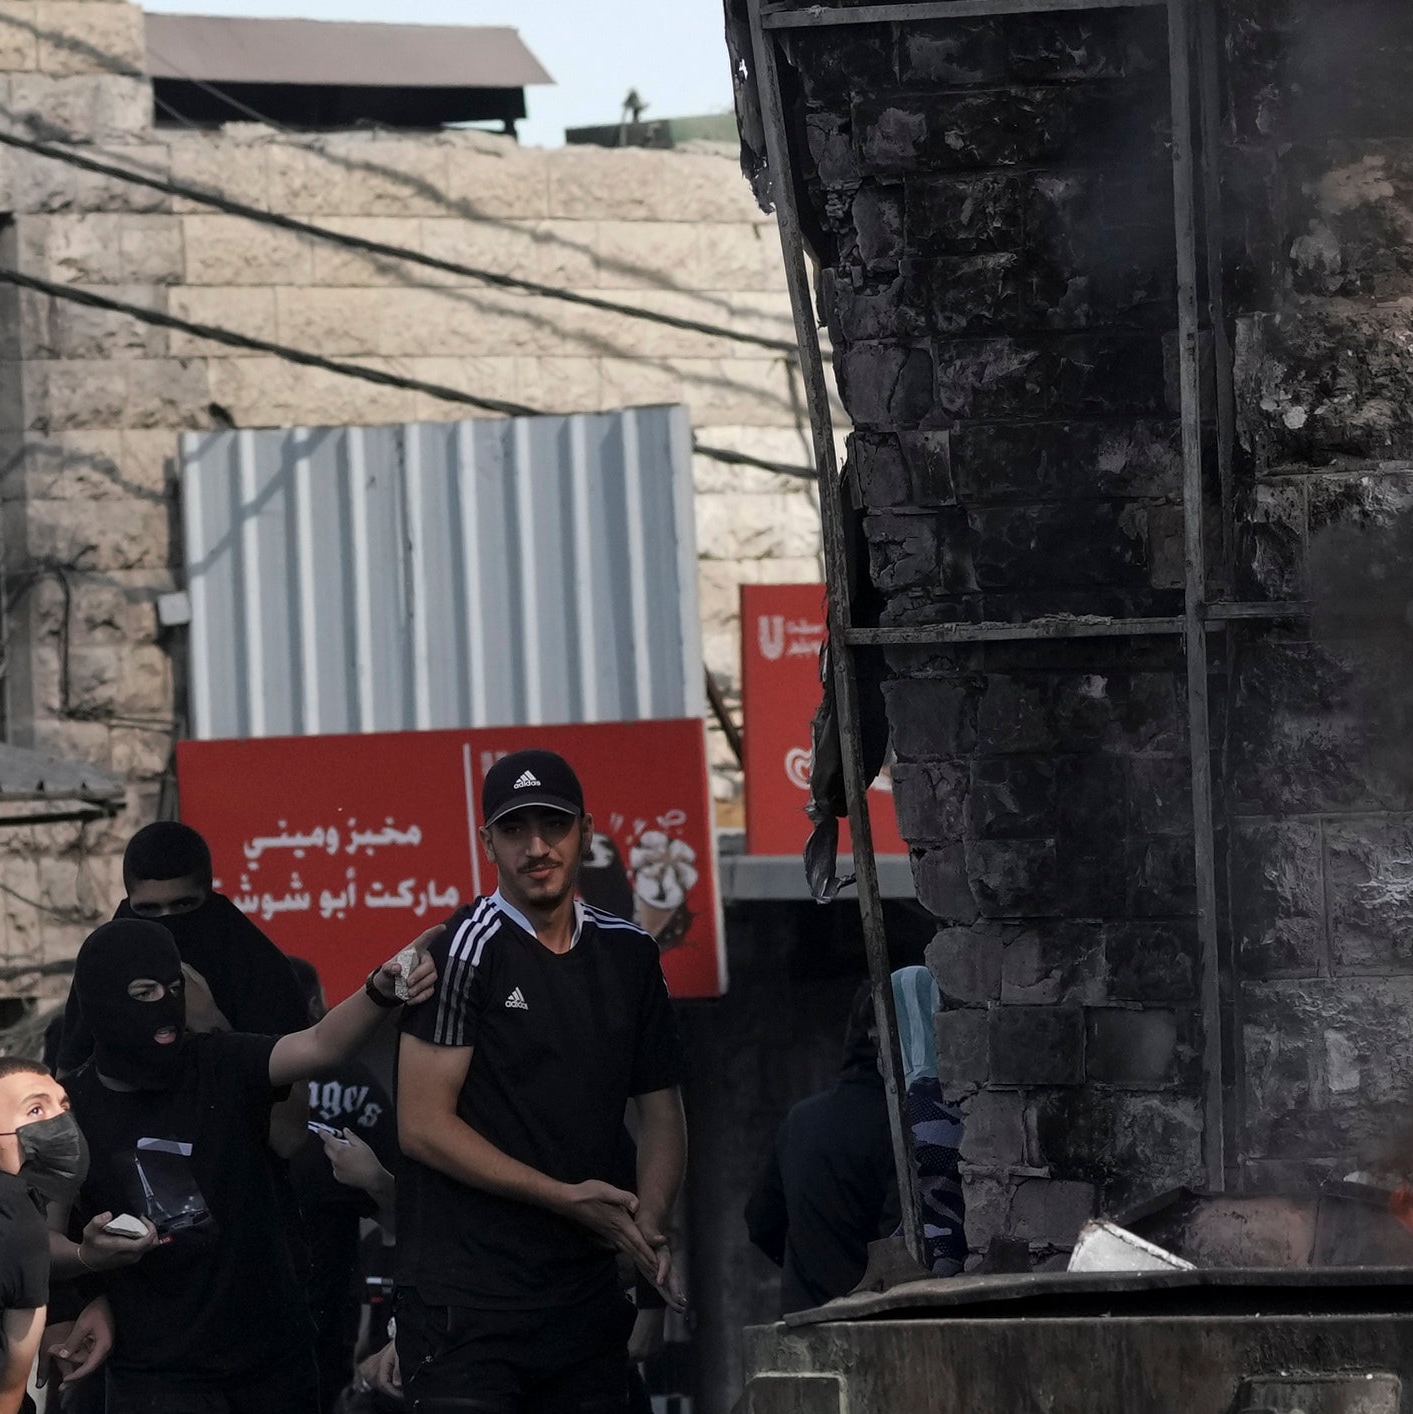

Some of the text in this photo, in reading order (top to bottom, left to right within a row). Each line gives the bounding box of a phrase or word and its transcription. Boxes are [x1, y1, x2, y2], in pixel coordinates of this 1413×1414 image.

[243, 816, 423, 871] مخبز وميني
[213, 865, 460, 921] ماركت أبو شوش
